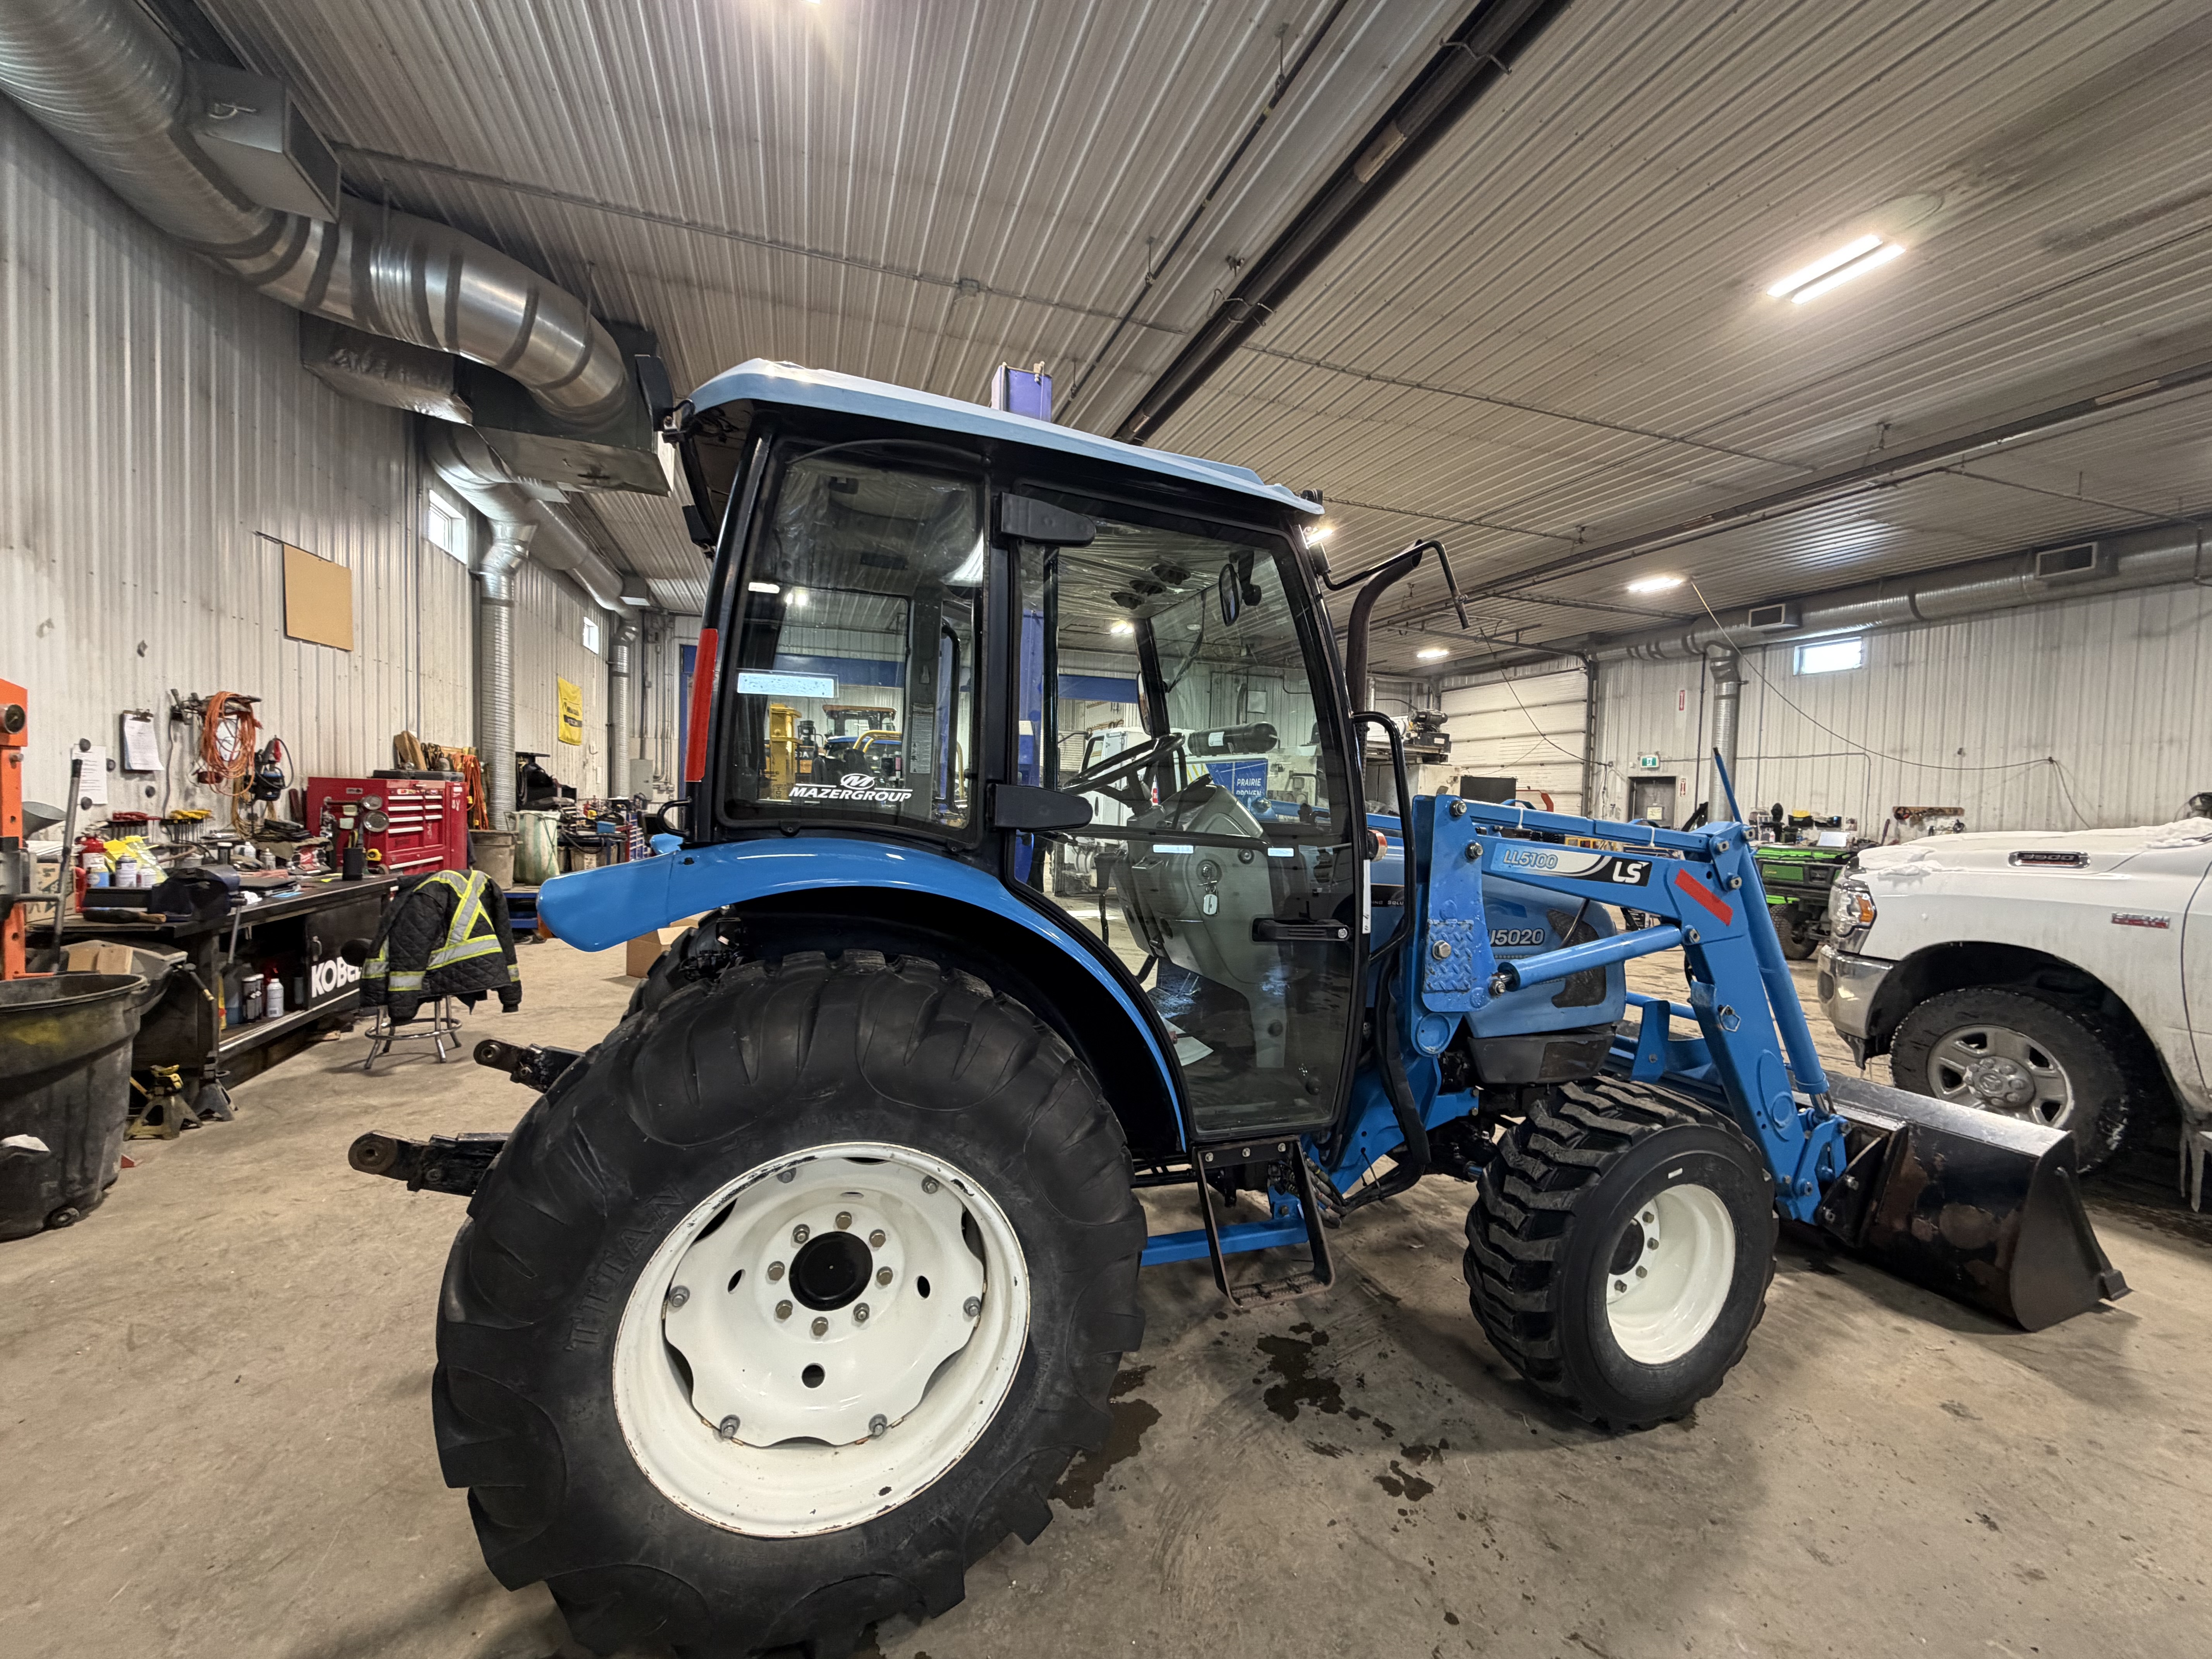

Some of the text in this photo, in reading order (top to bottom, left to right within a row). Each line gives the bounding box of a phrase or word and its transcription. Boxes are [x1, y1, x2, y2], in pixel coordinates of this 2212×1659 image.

[788, 787, 912, 802] MAZERGROUP
[1503, 850, 1558, 869] LL5100
[1613, 861, 1649, 884] LS
[563, 1184, 685, 1350] TITAN
